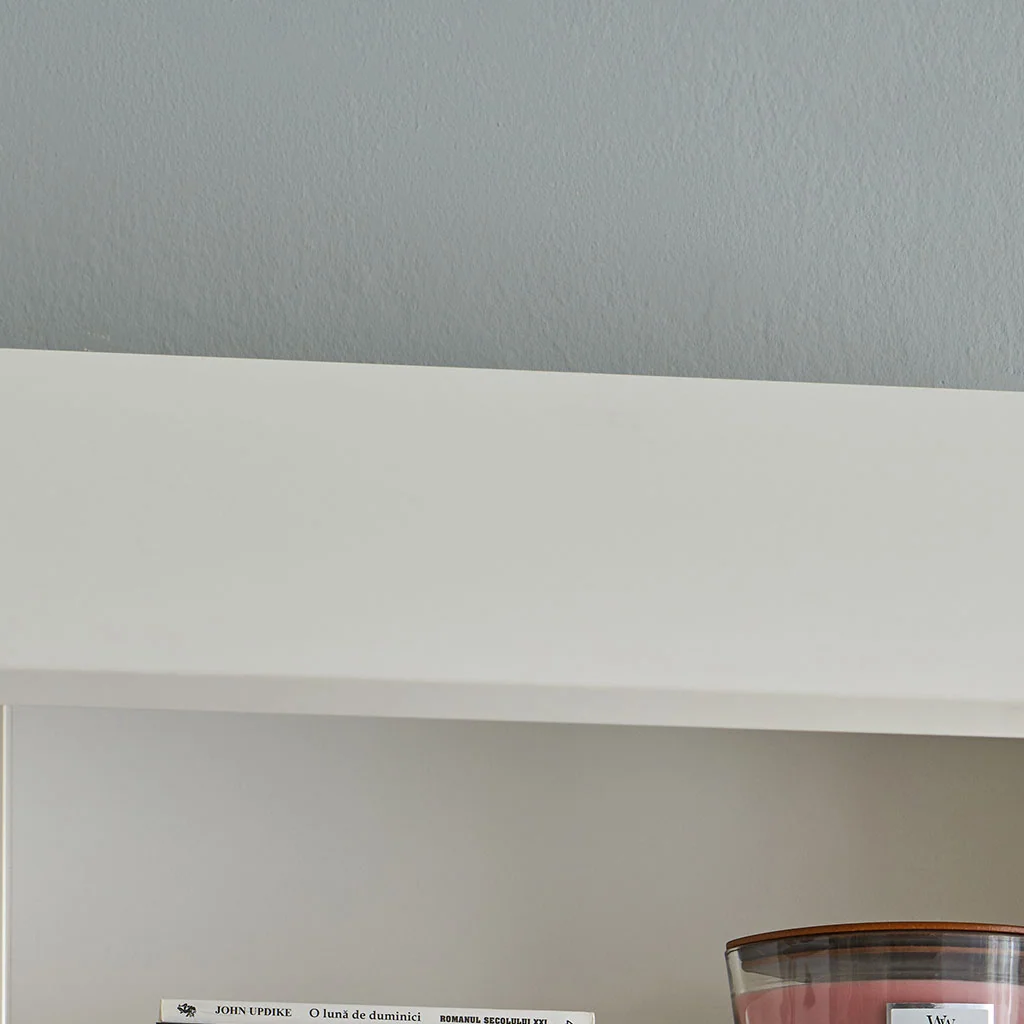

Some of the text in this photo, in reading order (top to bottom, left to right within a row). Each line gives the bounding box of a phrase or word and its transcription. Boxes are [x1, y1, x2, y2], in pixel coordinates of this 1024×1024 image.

[214, 1005, 293, 1017] JOHN UPDIKE
[309, 1007, 421, 1022] O lună de duminici
[439, 1015, 482, 1024] ROMANUL
